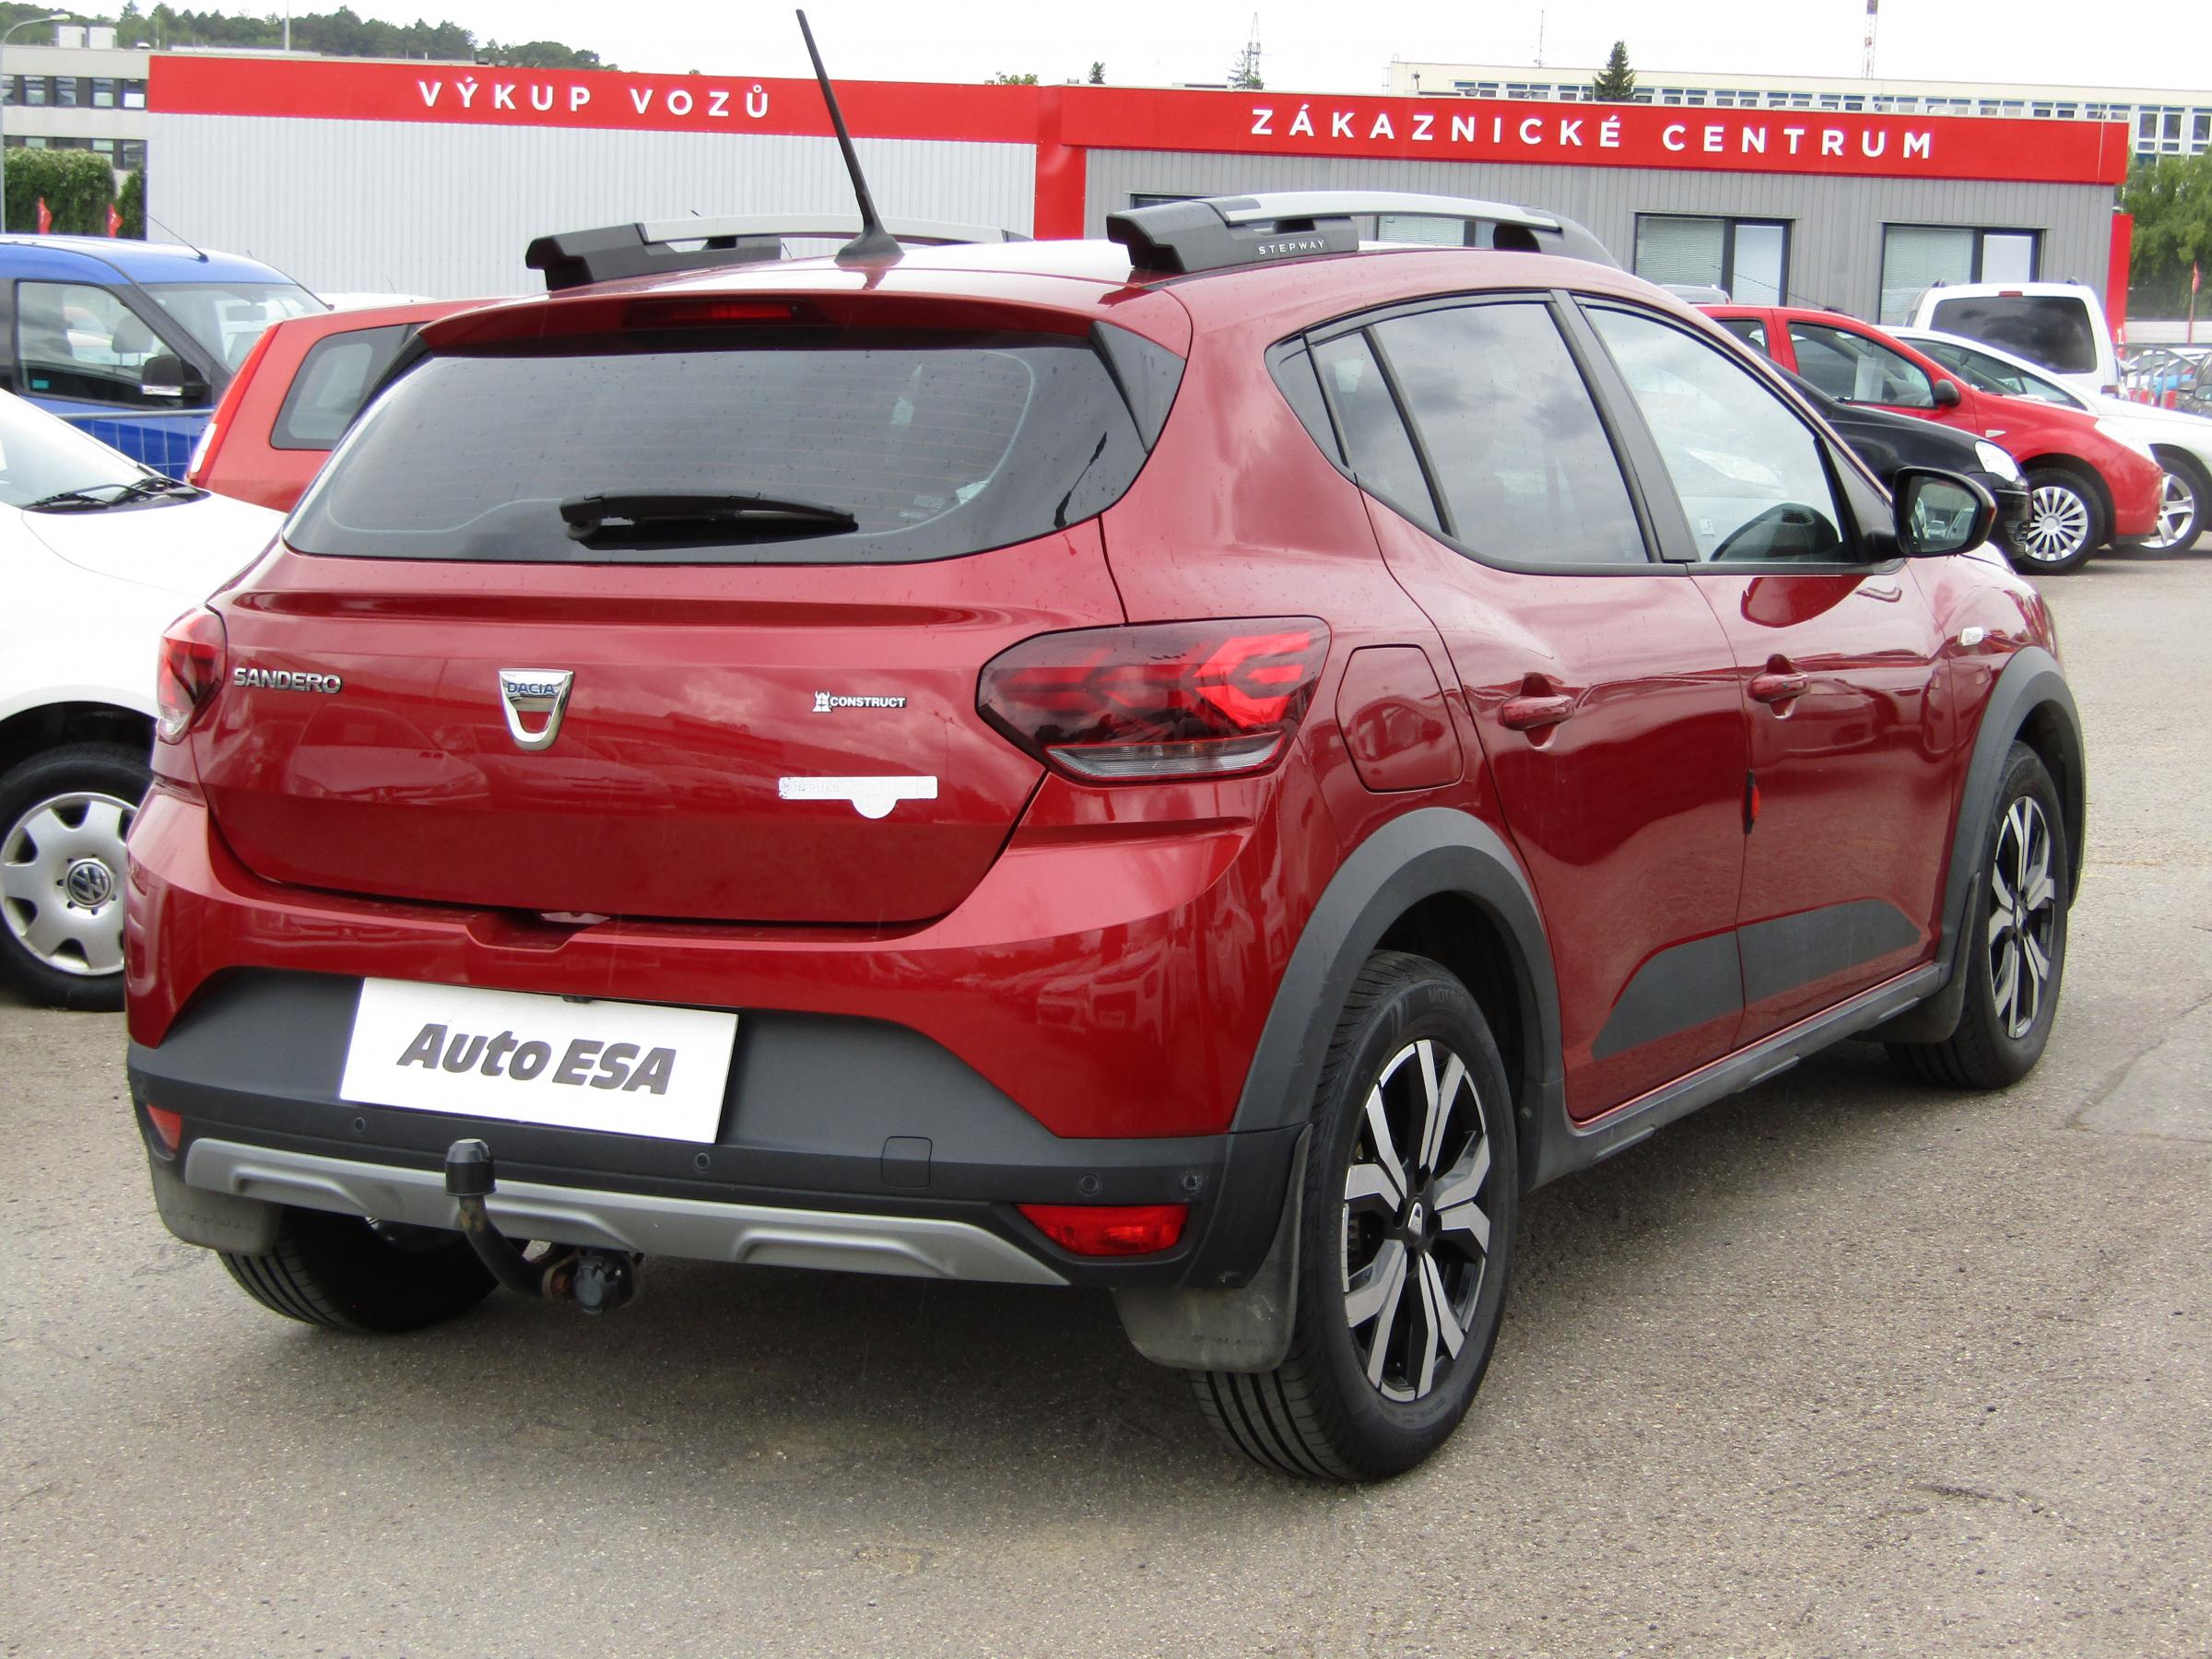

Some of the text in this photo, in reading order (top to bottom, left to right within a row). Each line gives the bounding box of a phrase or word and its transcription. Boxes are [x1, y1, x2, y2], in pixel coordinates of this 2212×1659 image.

[418, 76, 770, 119] VÝKUP VOZŮ
[1251, 104, 1932, 159] ZÁKAZNICKÉ CENTRUM
[1258, 239, 1326, 256] STEPWAY
[233, 667, 342, 694] SANDERO
[507, 682, 556, 694] DACIA
[830, 696, 906, 708] CONSTRUCT
[396, 1023, 677, 1095] Auto ESA
